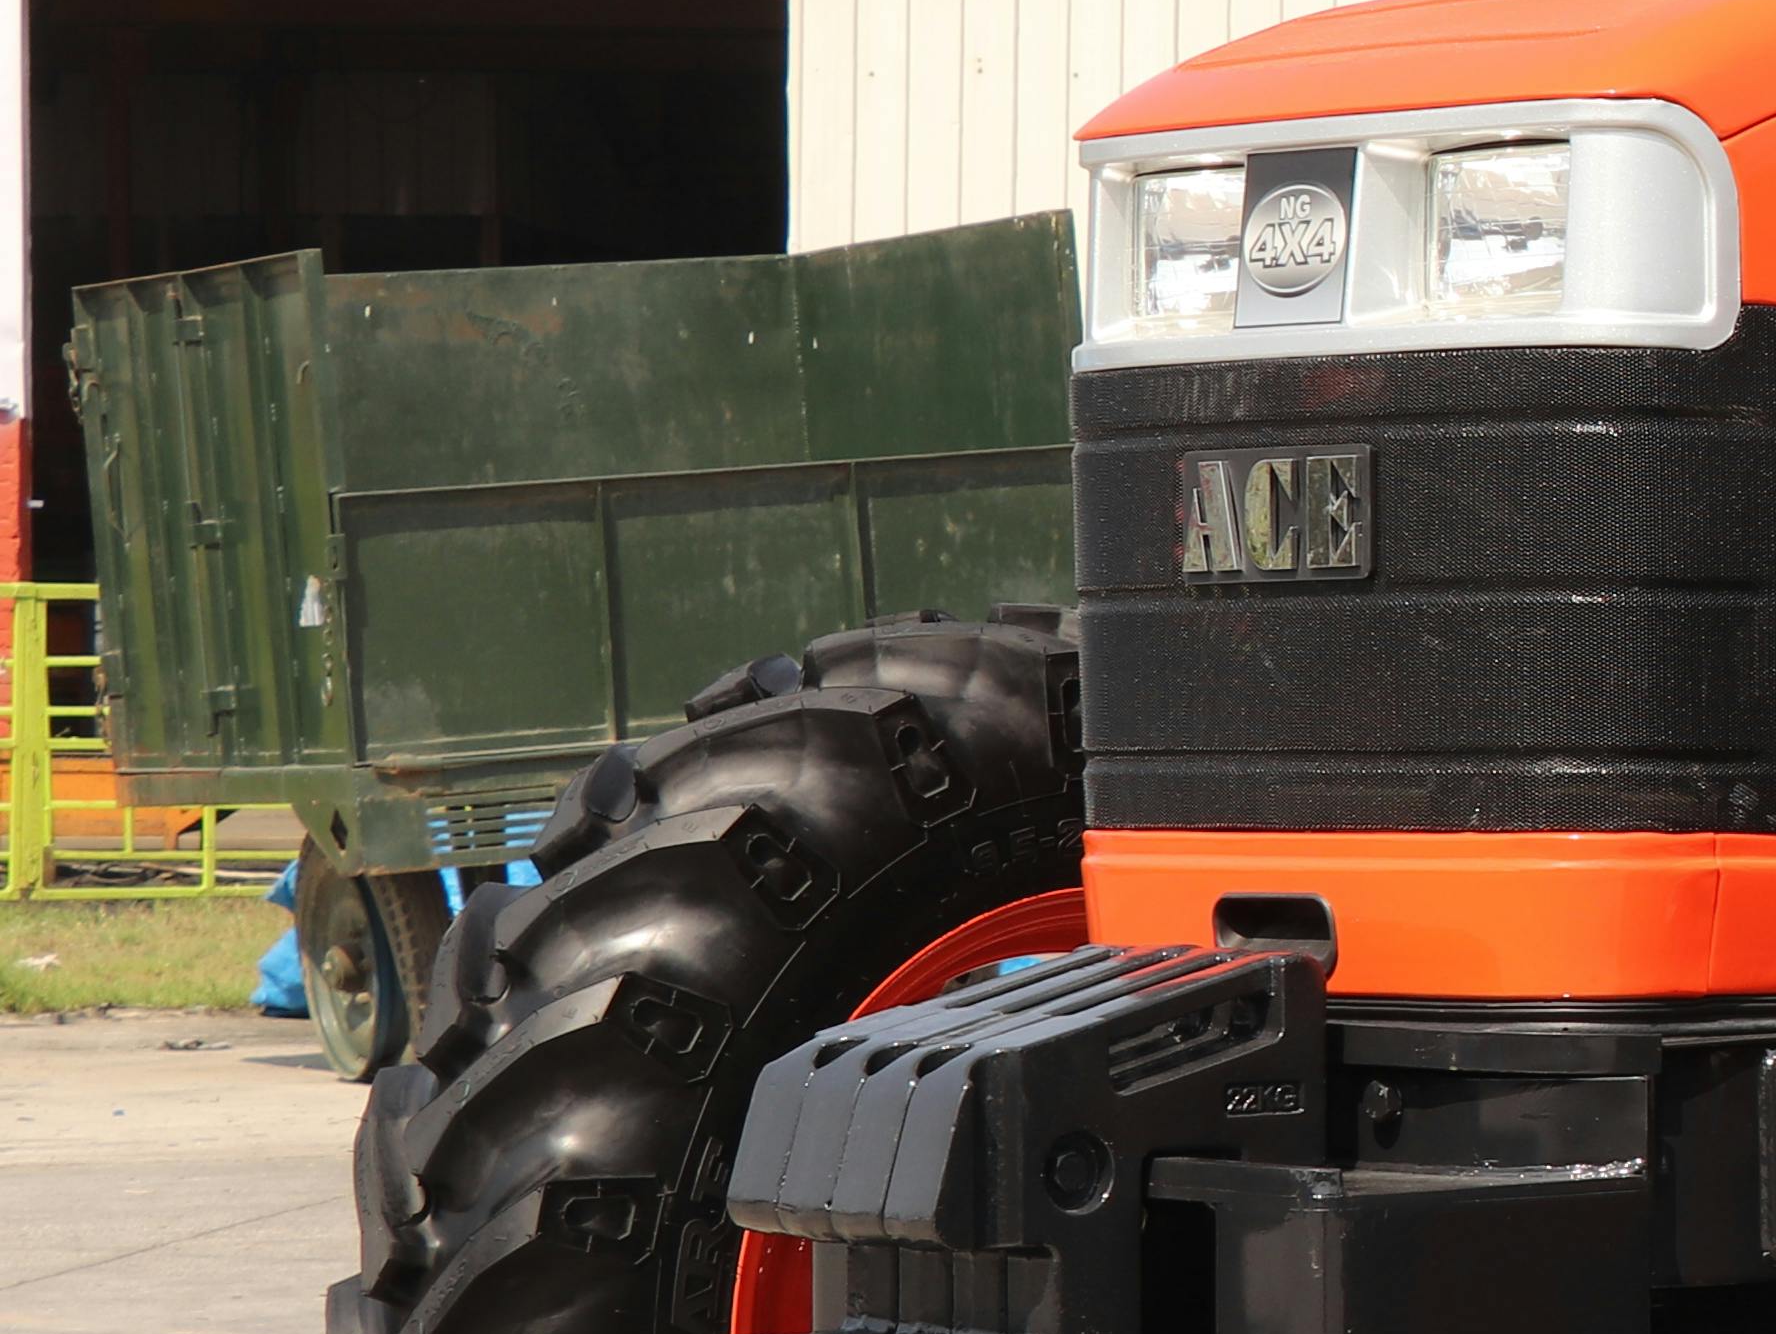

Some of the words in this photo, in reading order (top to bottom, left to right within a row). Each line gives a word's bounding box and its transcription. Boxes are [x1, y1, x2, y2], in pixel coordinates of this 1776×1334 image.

[1279, 195, 1312, 221] NG
[1249, 216, 1338, 269] 4X4
[1181, 454, 1365, 575] ACE
[969, 817, 1085, 875] 9.5-2
[1225, 1082, 1304, 1117] 22KG
